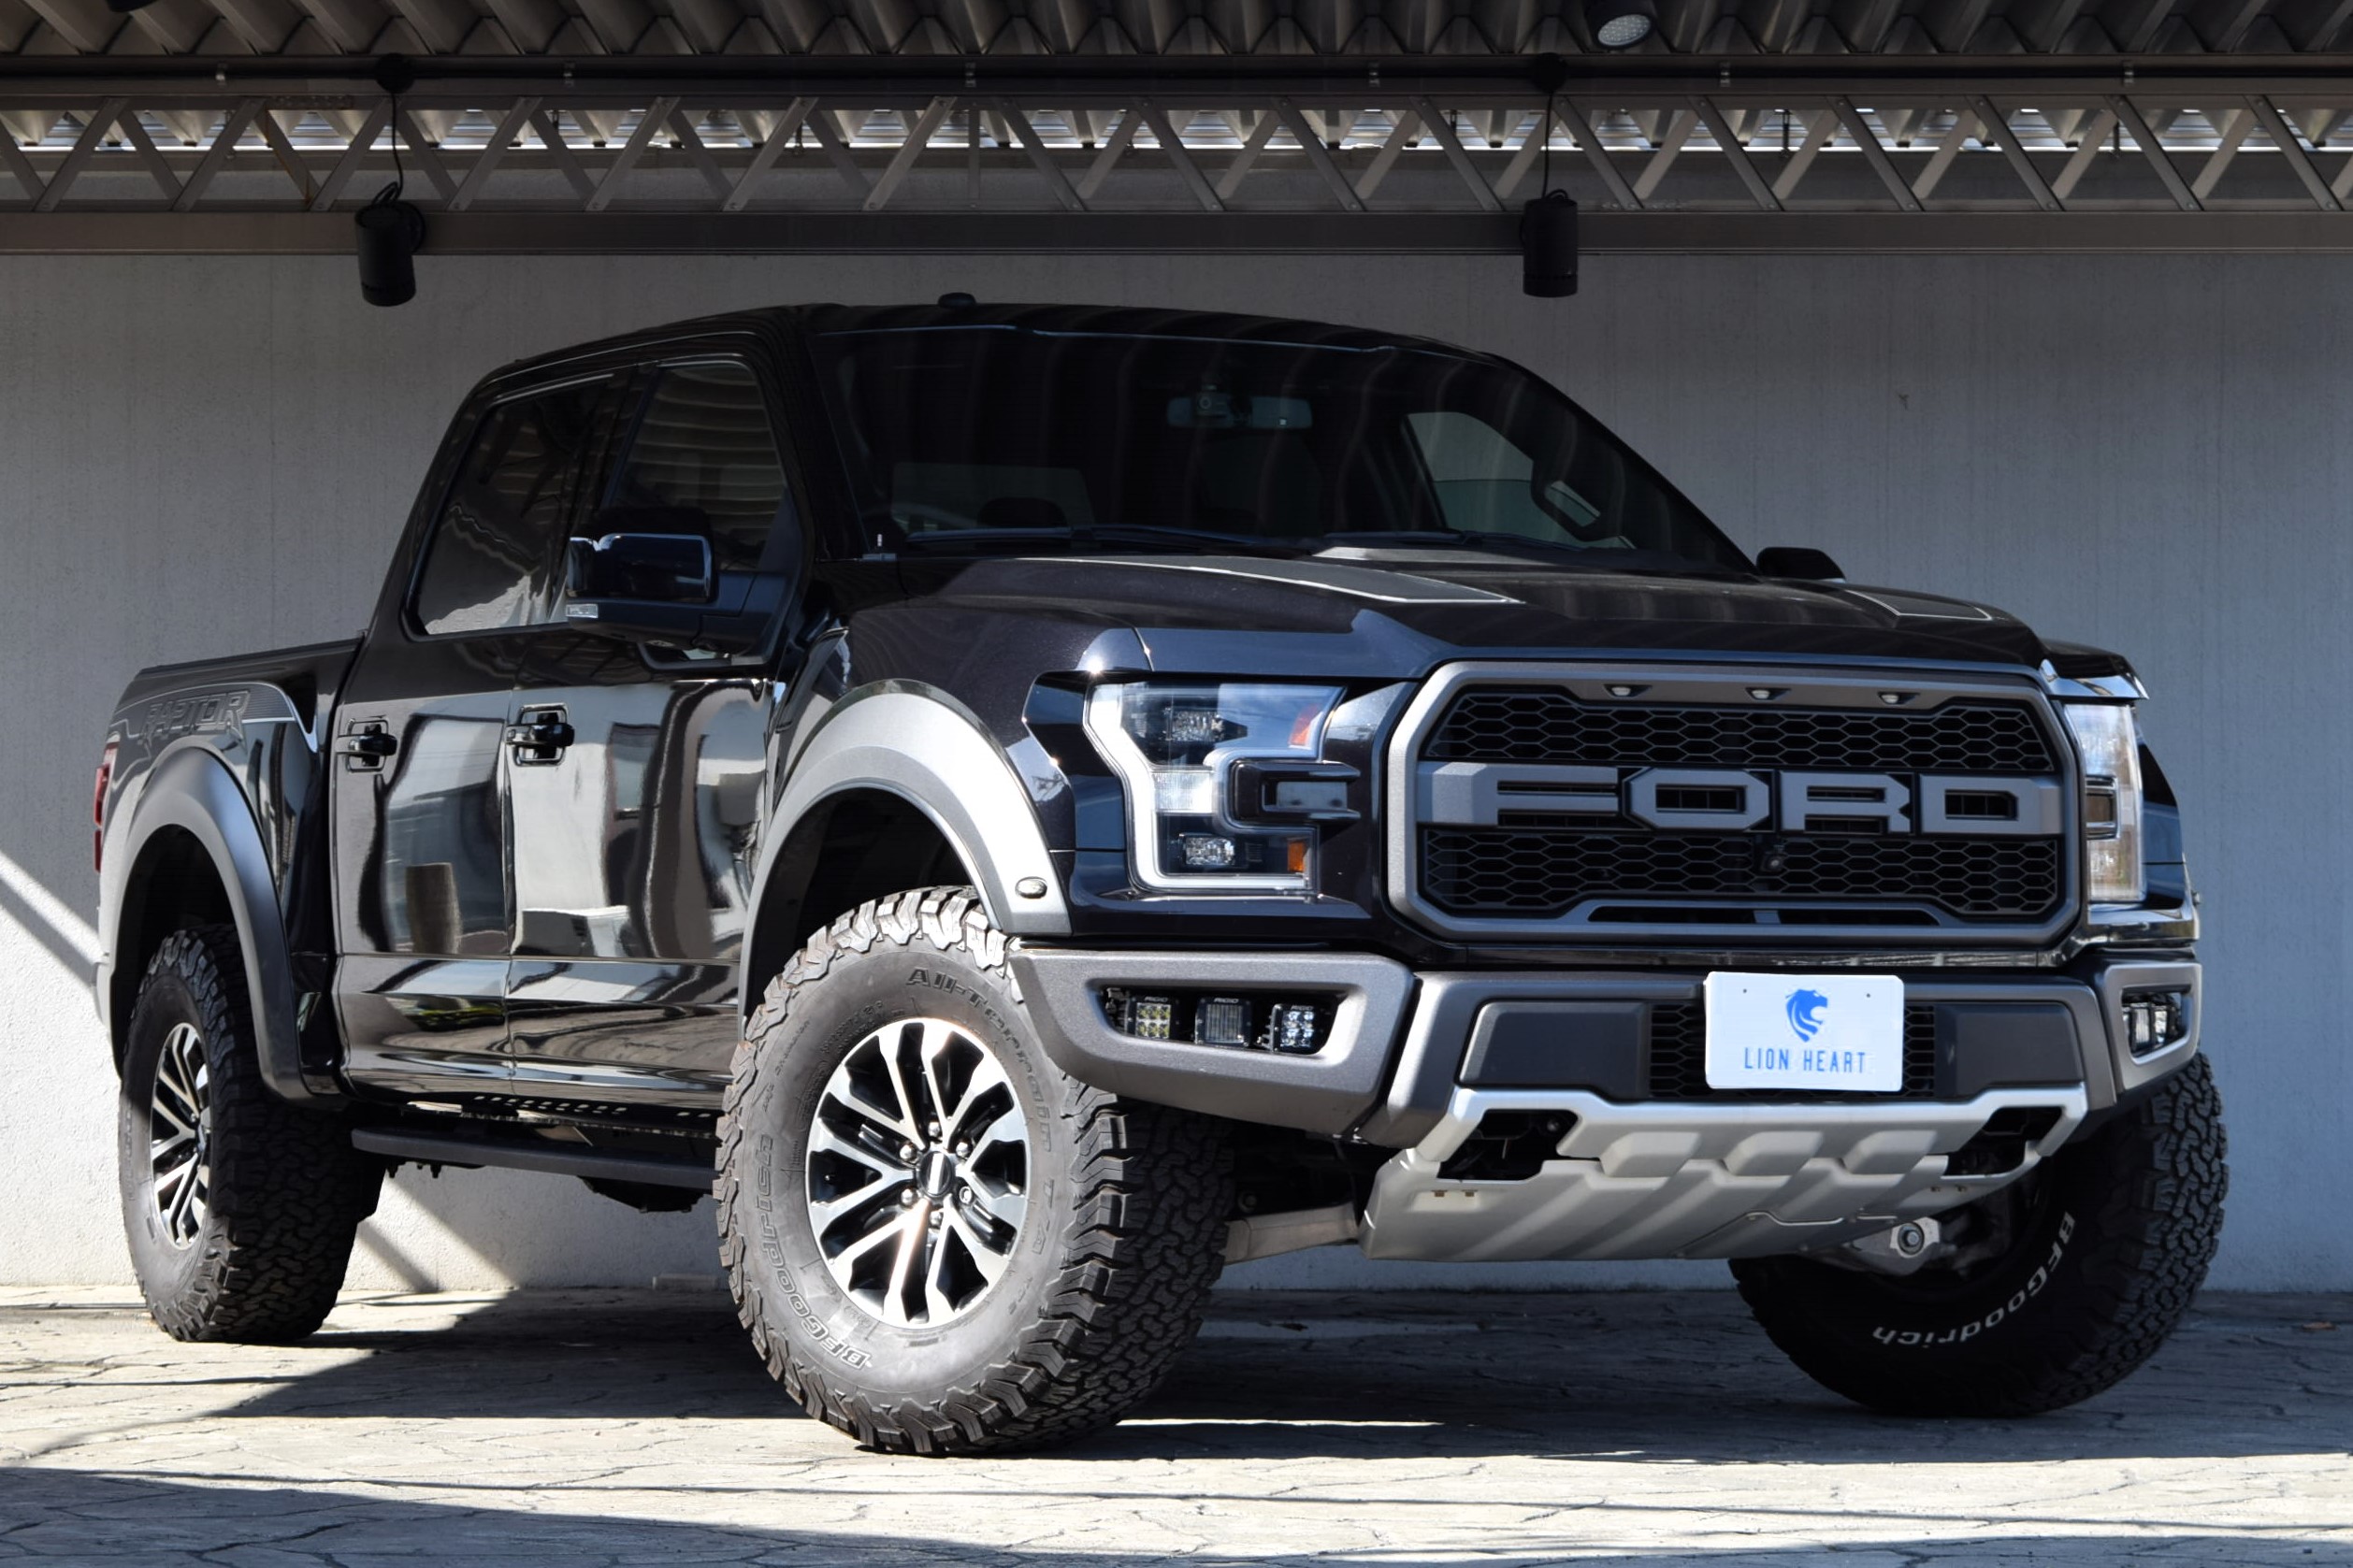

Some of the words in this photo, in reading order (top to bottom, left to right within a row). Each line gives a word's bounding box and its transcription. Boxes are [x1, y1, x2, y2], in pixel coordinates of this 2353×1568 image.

[1418, 761, 2064, 834] FORD
[1743, 1047, 1789, 1071] LION
[1803, 1050, 1866, 1074] HEART
[1872, 1212, 2075, 1348] BFGoodrich
